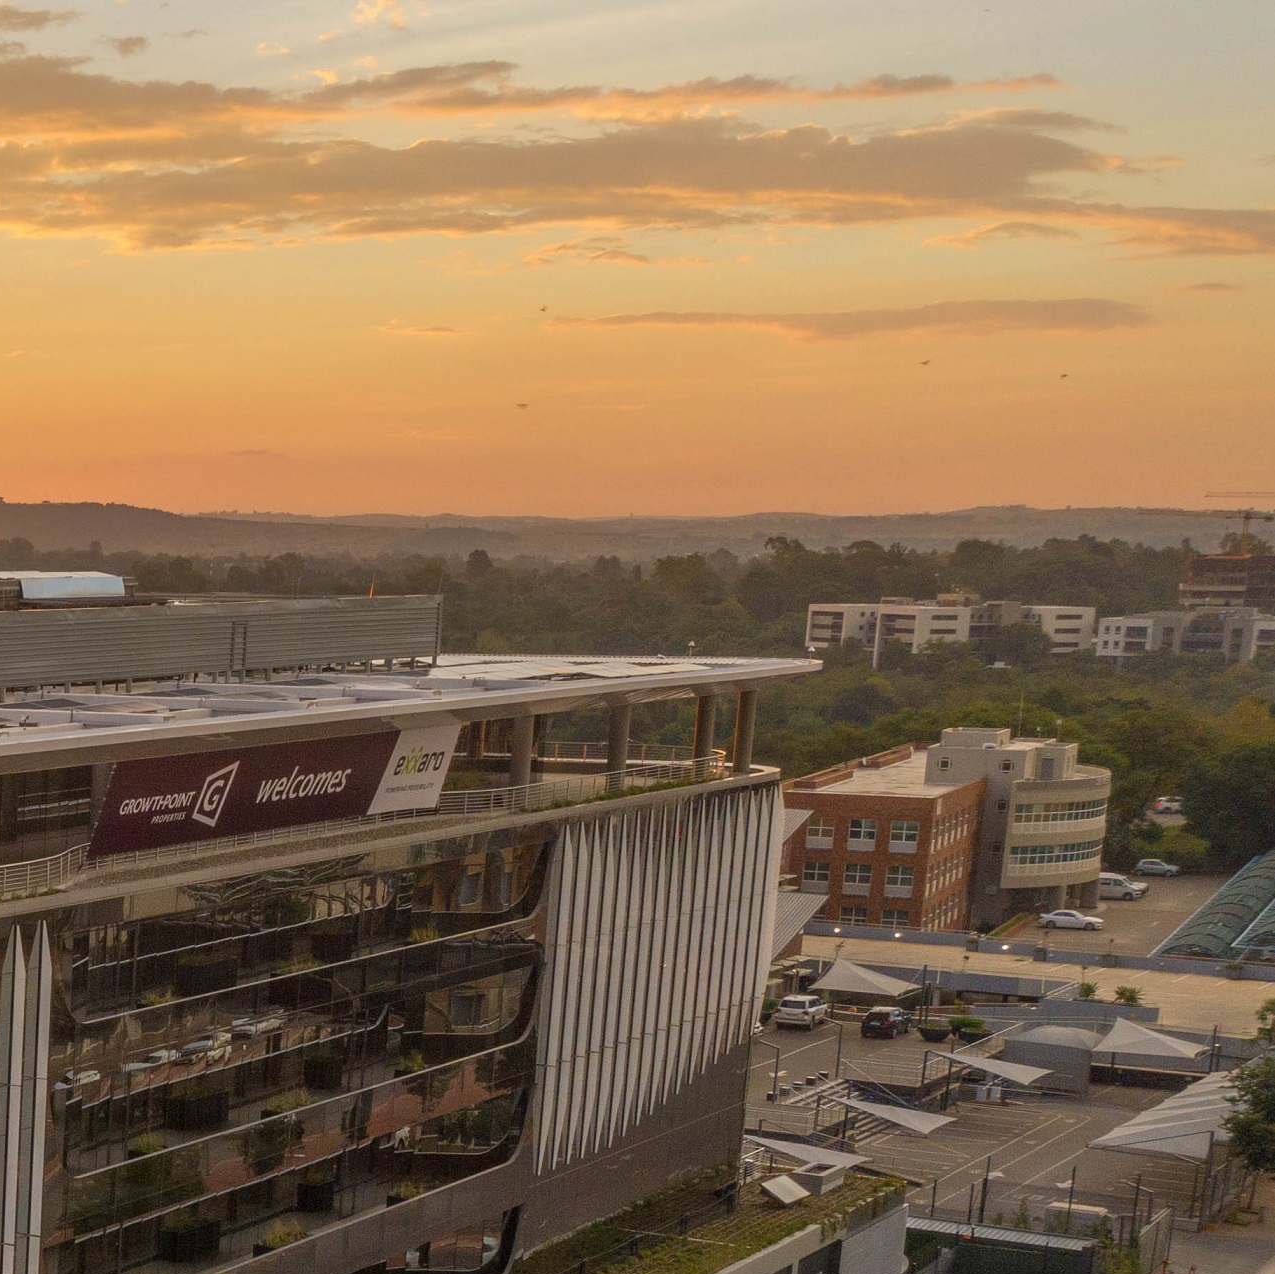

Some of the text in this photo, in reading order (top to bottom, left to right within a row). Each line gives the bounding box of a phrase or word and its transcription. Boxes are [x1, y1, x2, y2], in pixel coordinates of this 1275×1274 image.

[393, 745, 445, 775] exxaro
[255, 765, 352, 804] welcomes
[119, 791, 196, 815] GROWTHPOINT
[151, 812, 187, 825] PROPERTIES
